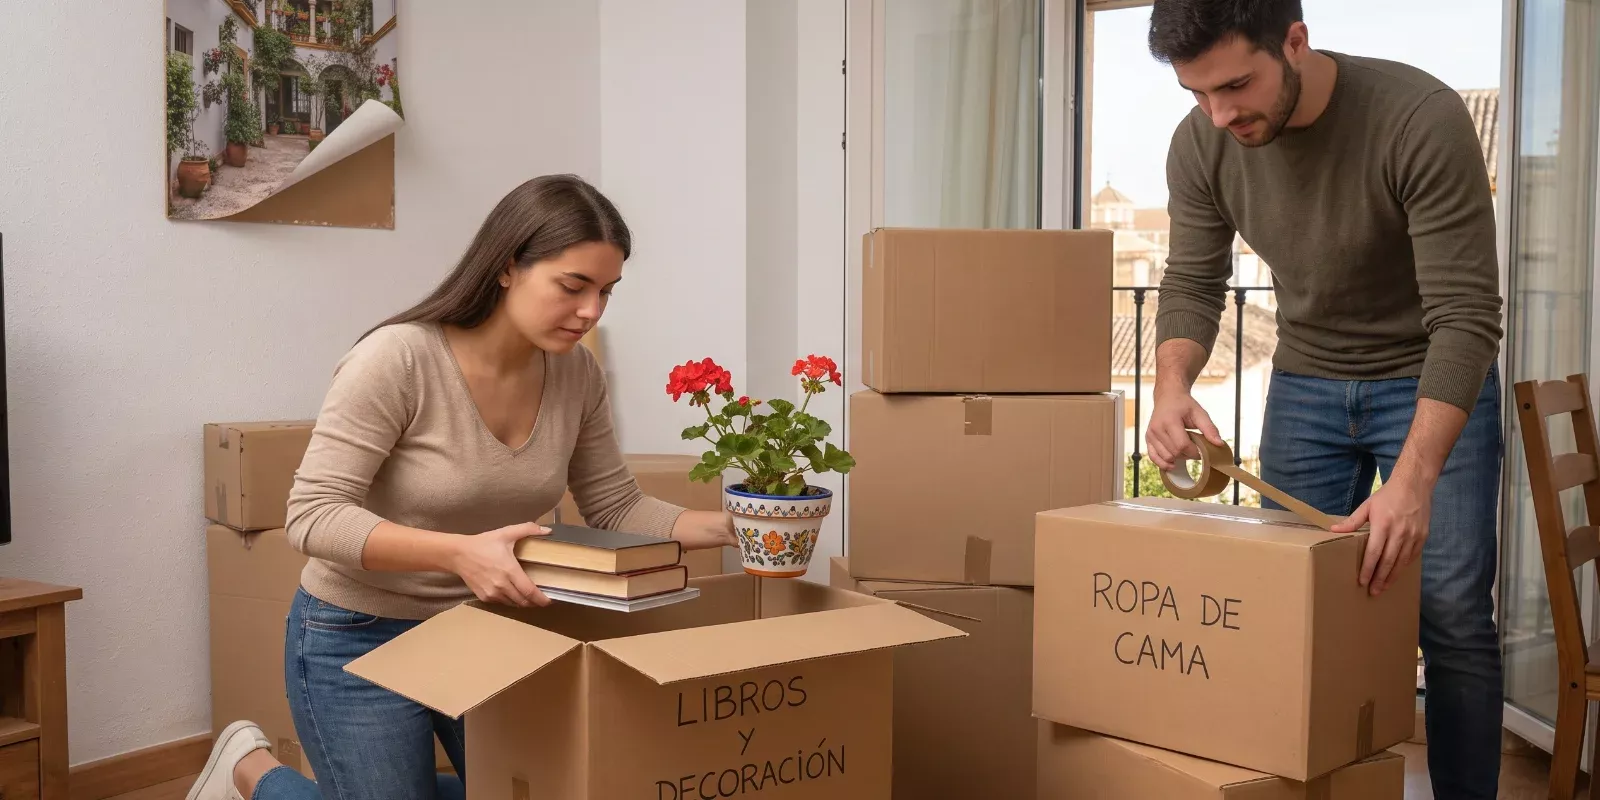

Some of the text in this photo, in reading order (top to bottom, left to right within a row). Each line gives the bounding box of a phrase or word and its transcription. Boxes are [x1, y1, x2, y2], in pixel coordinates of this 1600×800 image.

[1093, 572, 1242, 630] ROPA DE
[1114, 631, 1210, 679] CAMA
[677, 676, 807, 727] LIBROS
